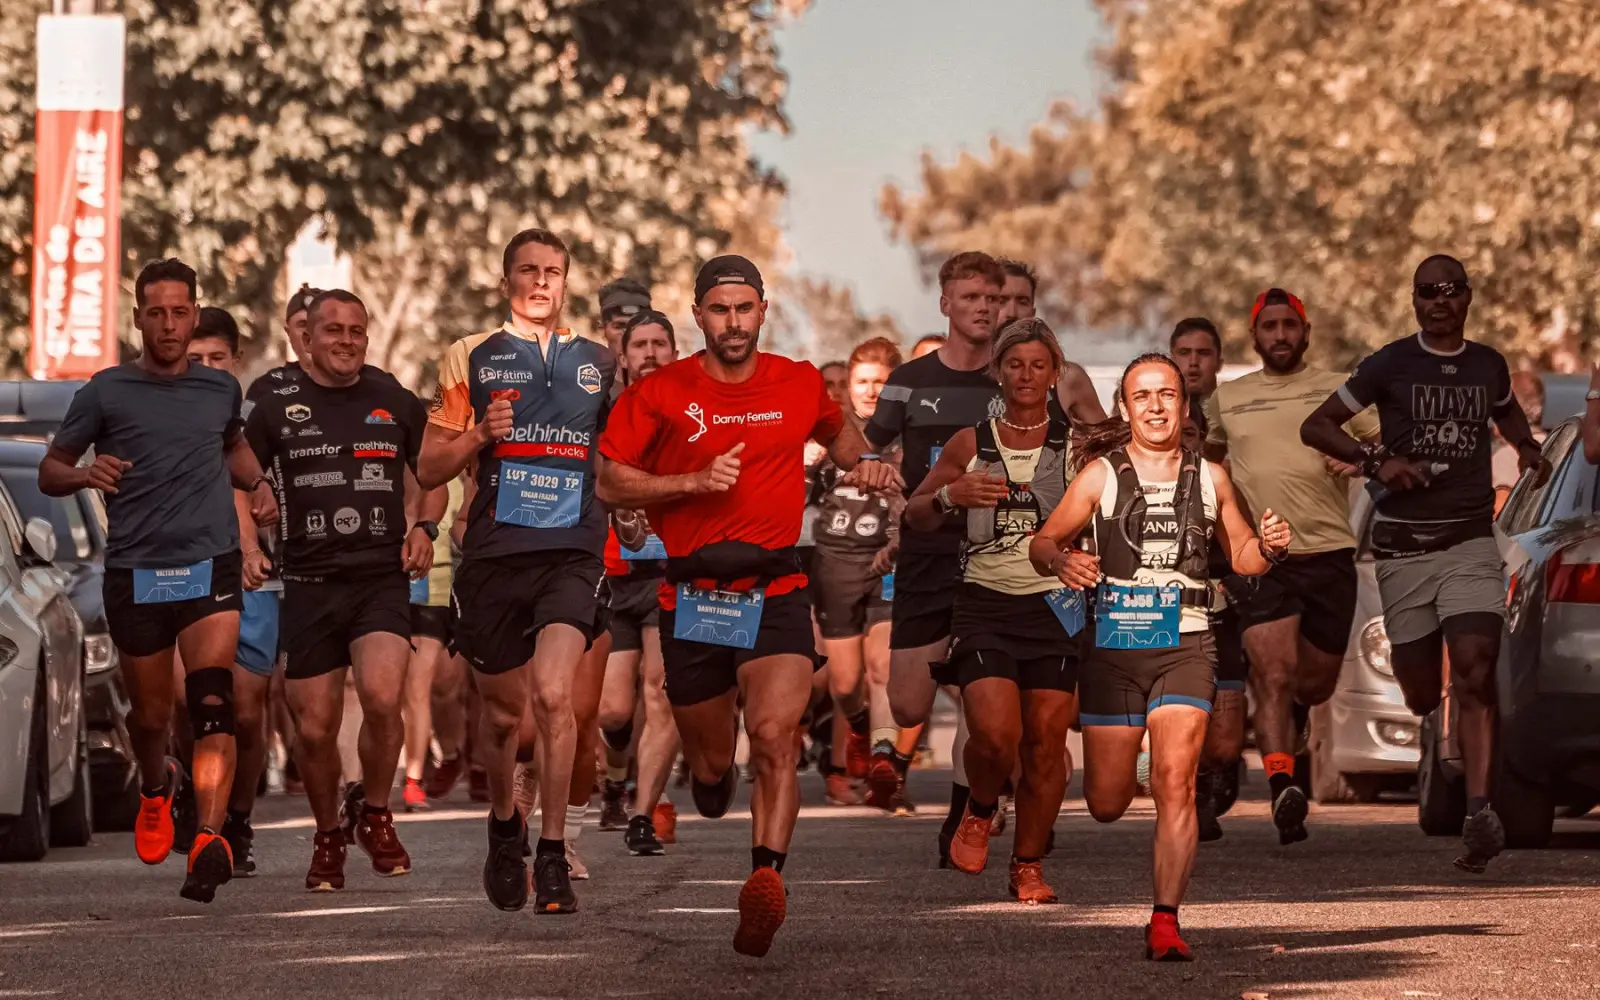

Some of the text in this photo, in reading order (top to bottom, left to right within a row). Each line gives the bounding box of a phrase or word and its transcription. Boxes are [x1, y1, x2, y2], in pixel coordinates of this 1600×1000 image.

[76, 128, 108, 208] AIRE
[73, 216, 104, 263] DE
[71, 269, 103, 357] MIRA
[496, 369, 533, 380] Fátima
[273, 385, 300, 396] NEO
[1412, 384, 1487, 422] MAXI
[712, 410, 783, 425] Danny Ferreira
[502, 423, 590, 446] oelhinhos
[289, 444, 342, 459] transfor
[353, 441, 398, 452] coelhinhos
[546, 446, 585, 458] trucks
[506, 468, 527, 481] LUT
[530, 474, 559, 489] 3029
[564, 477, 579, 489] TP
[697, 604, 742, 618] DANNY FERREIRA
